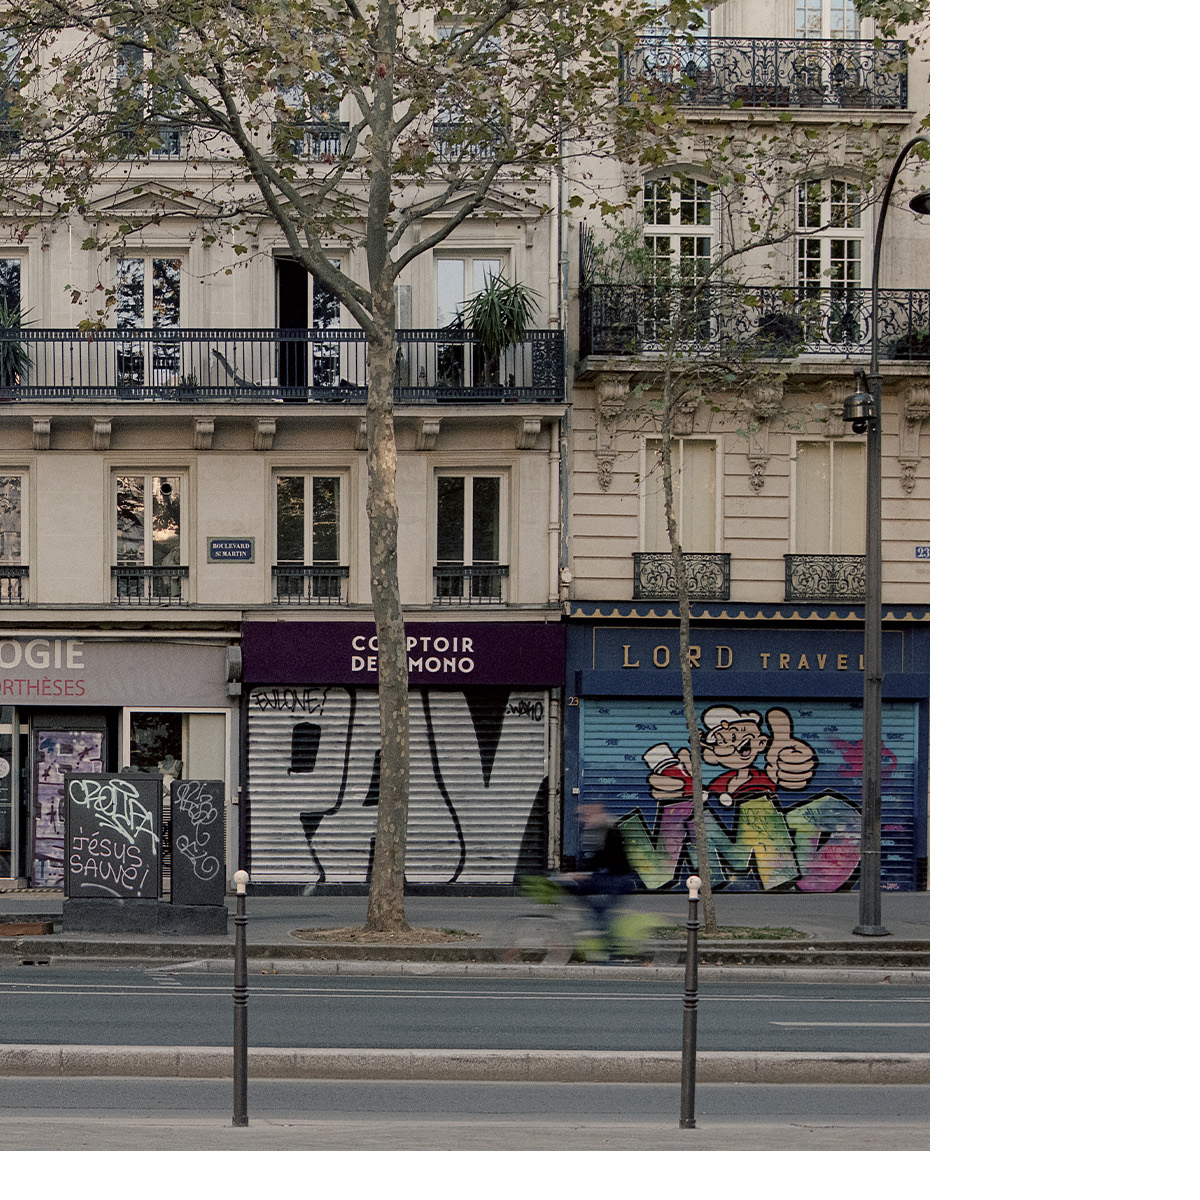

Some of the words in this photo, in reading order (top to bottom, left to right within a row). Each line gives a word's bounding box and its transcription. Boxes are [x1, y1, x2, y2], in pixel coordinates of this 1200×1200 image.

[917, 547, 930, 558] 23
[351, 635, 475, 653] COPTOIR
[622, 644, 733, 669] LORD
[408, 657, 475, 674] MONO
[568, 696, 579, 706] 23
